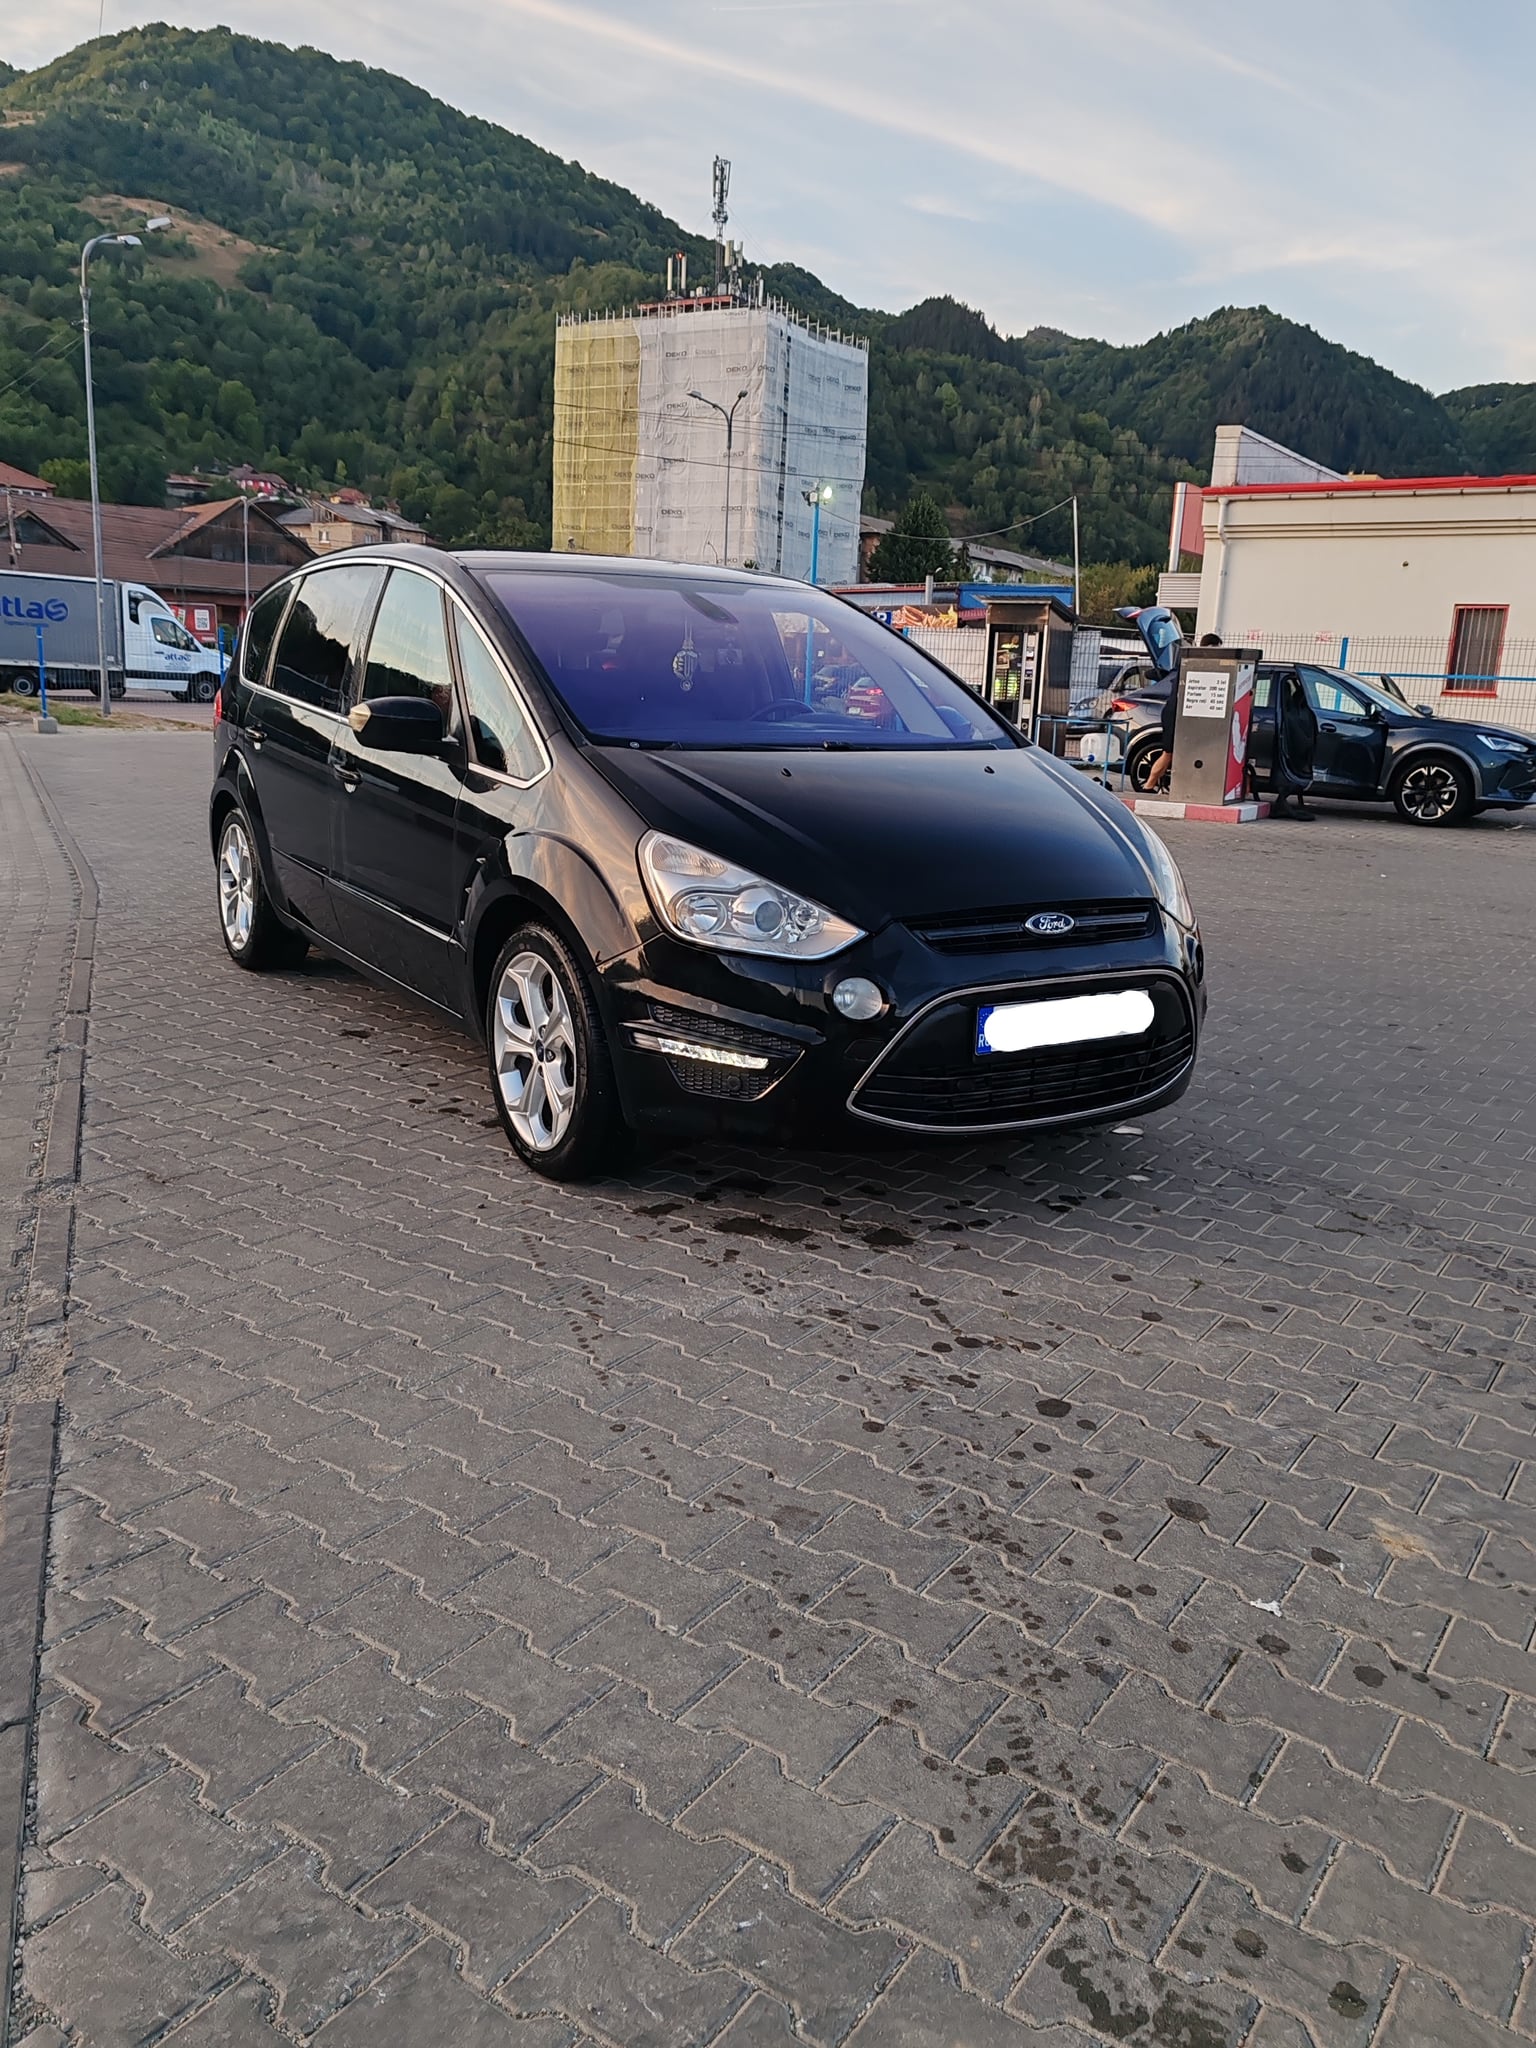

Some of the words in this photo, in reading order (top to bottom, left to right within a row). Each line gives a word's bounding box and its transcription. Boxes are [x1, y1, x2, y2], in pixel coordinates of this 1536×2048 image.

[726, 365, 748, 373] DEKO
[667, 402, 688, 410] DEKO
[635, 472, 656, 480] DEKO
[0, 596, 68, 622] tlas
[1039, 915, 1066, 931] Ford
